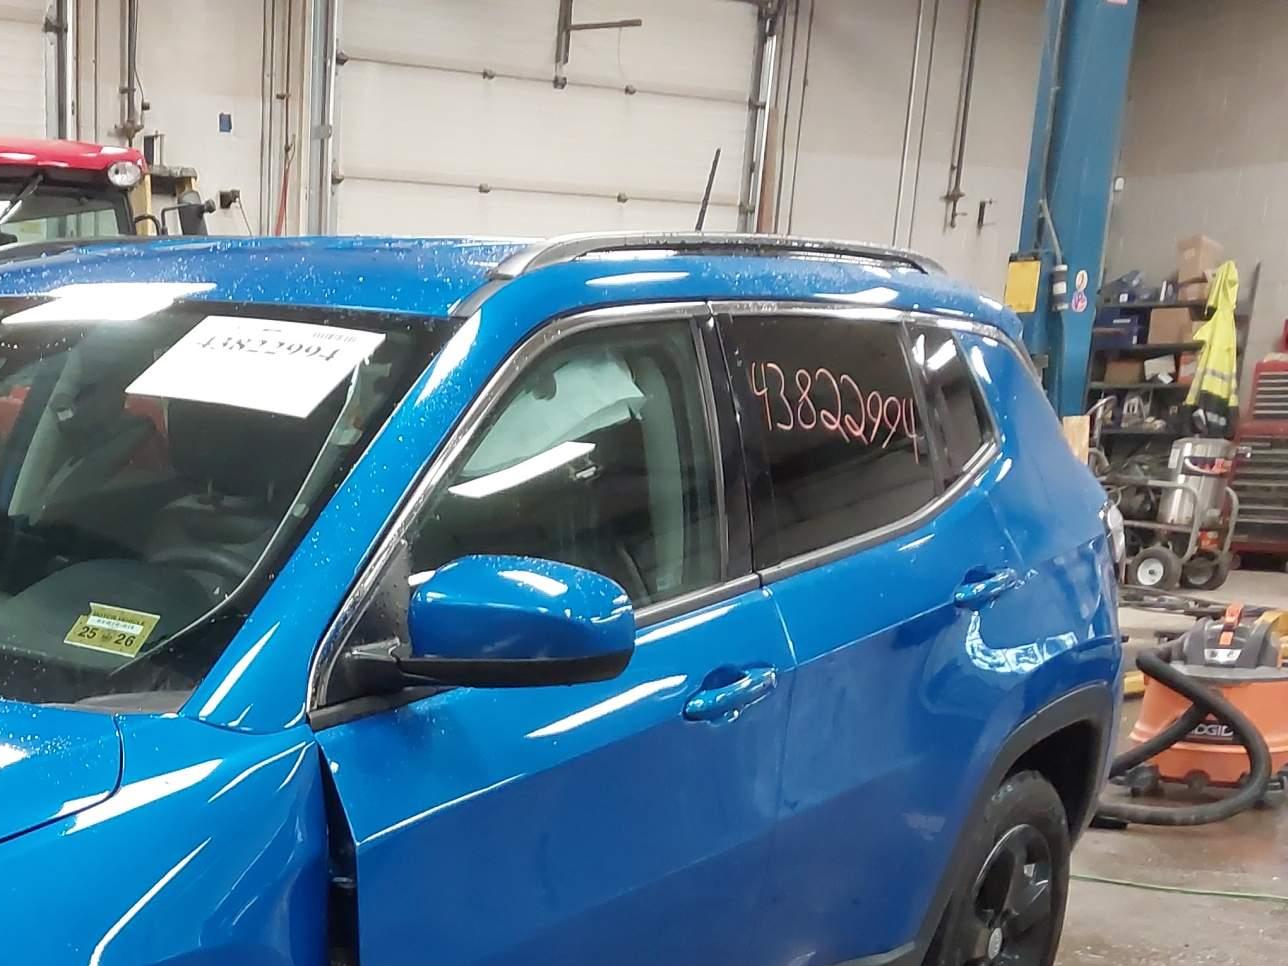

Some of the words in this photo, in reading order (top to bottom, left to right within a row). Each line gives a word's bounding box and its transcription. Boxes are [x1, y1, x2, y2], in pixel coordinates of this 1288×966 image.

[750, 362, 924, 465] 43822994
[78, 626, 98, 639] 25
[114, 633, 136, 647] 26
